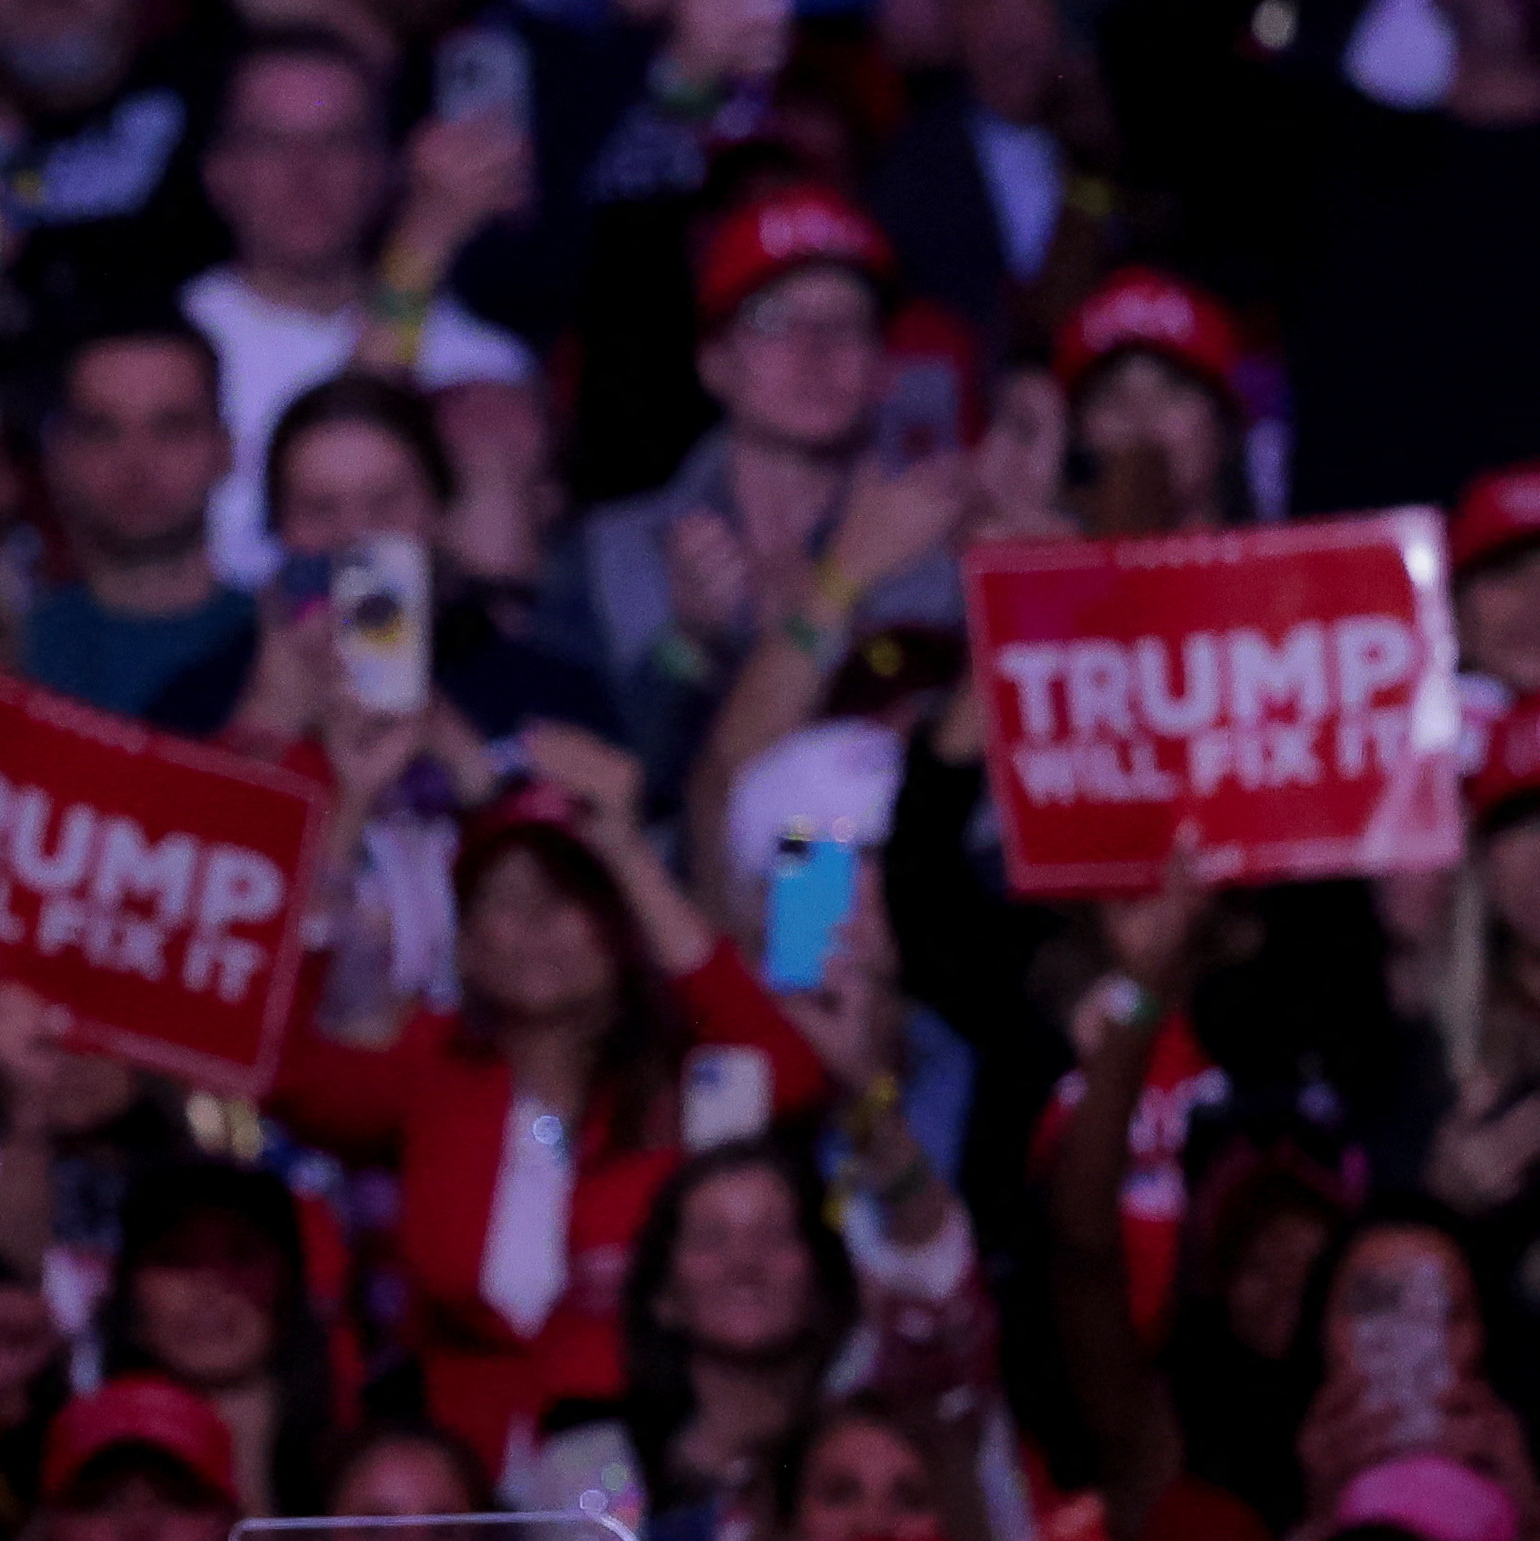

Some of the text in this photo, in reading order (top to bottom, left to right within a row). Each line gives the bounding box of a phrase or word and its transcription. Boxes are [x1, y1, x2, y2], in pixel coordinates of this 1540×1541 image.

[993, 612, 1416, 740] TRUMP
[1013, 742, 1183, 811] WILL
[1184, 722, 1325, 800] FIX
[33, 888, 169, 984] FIX
[179, 930, 271, 1004] IT
